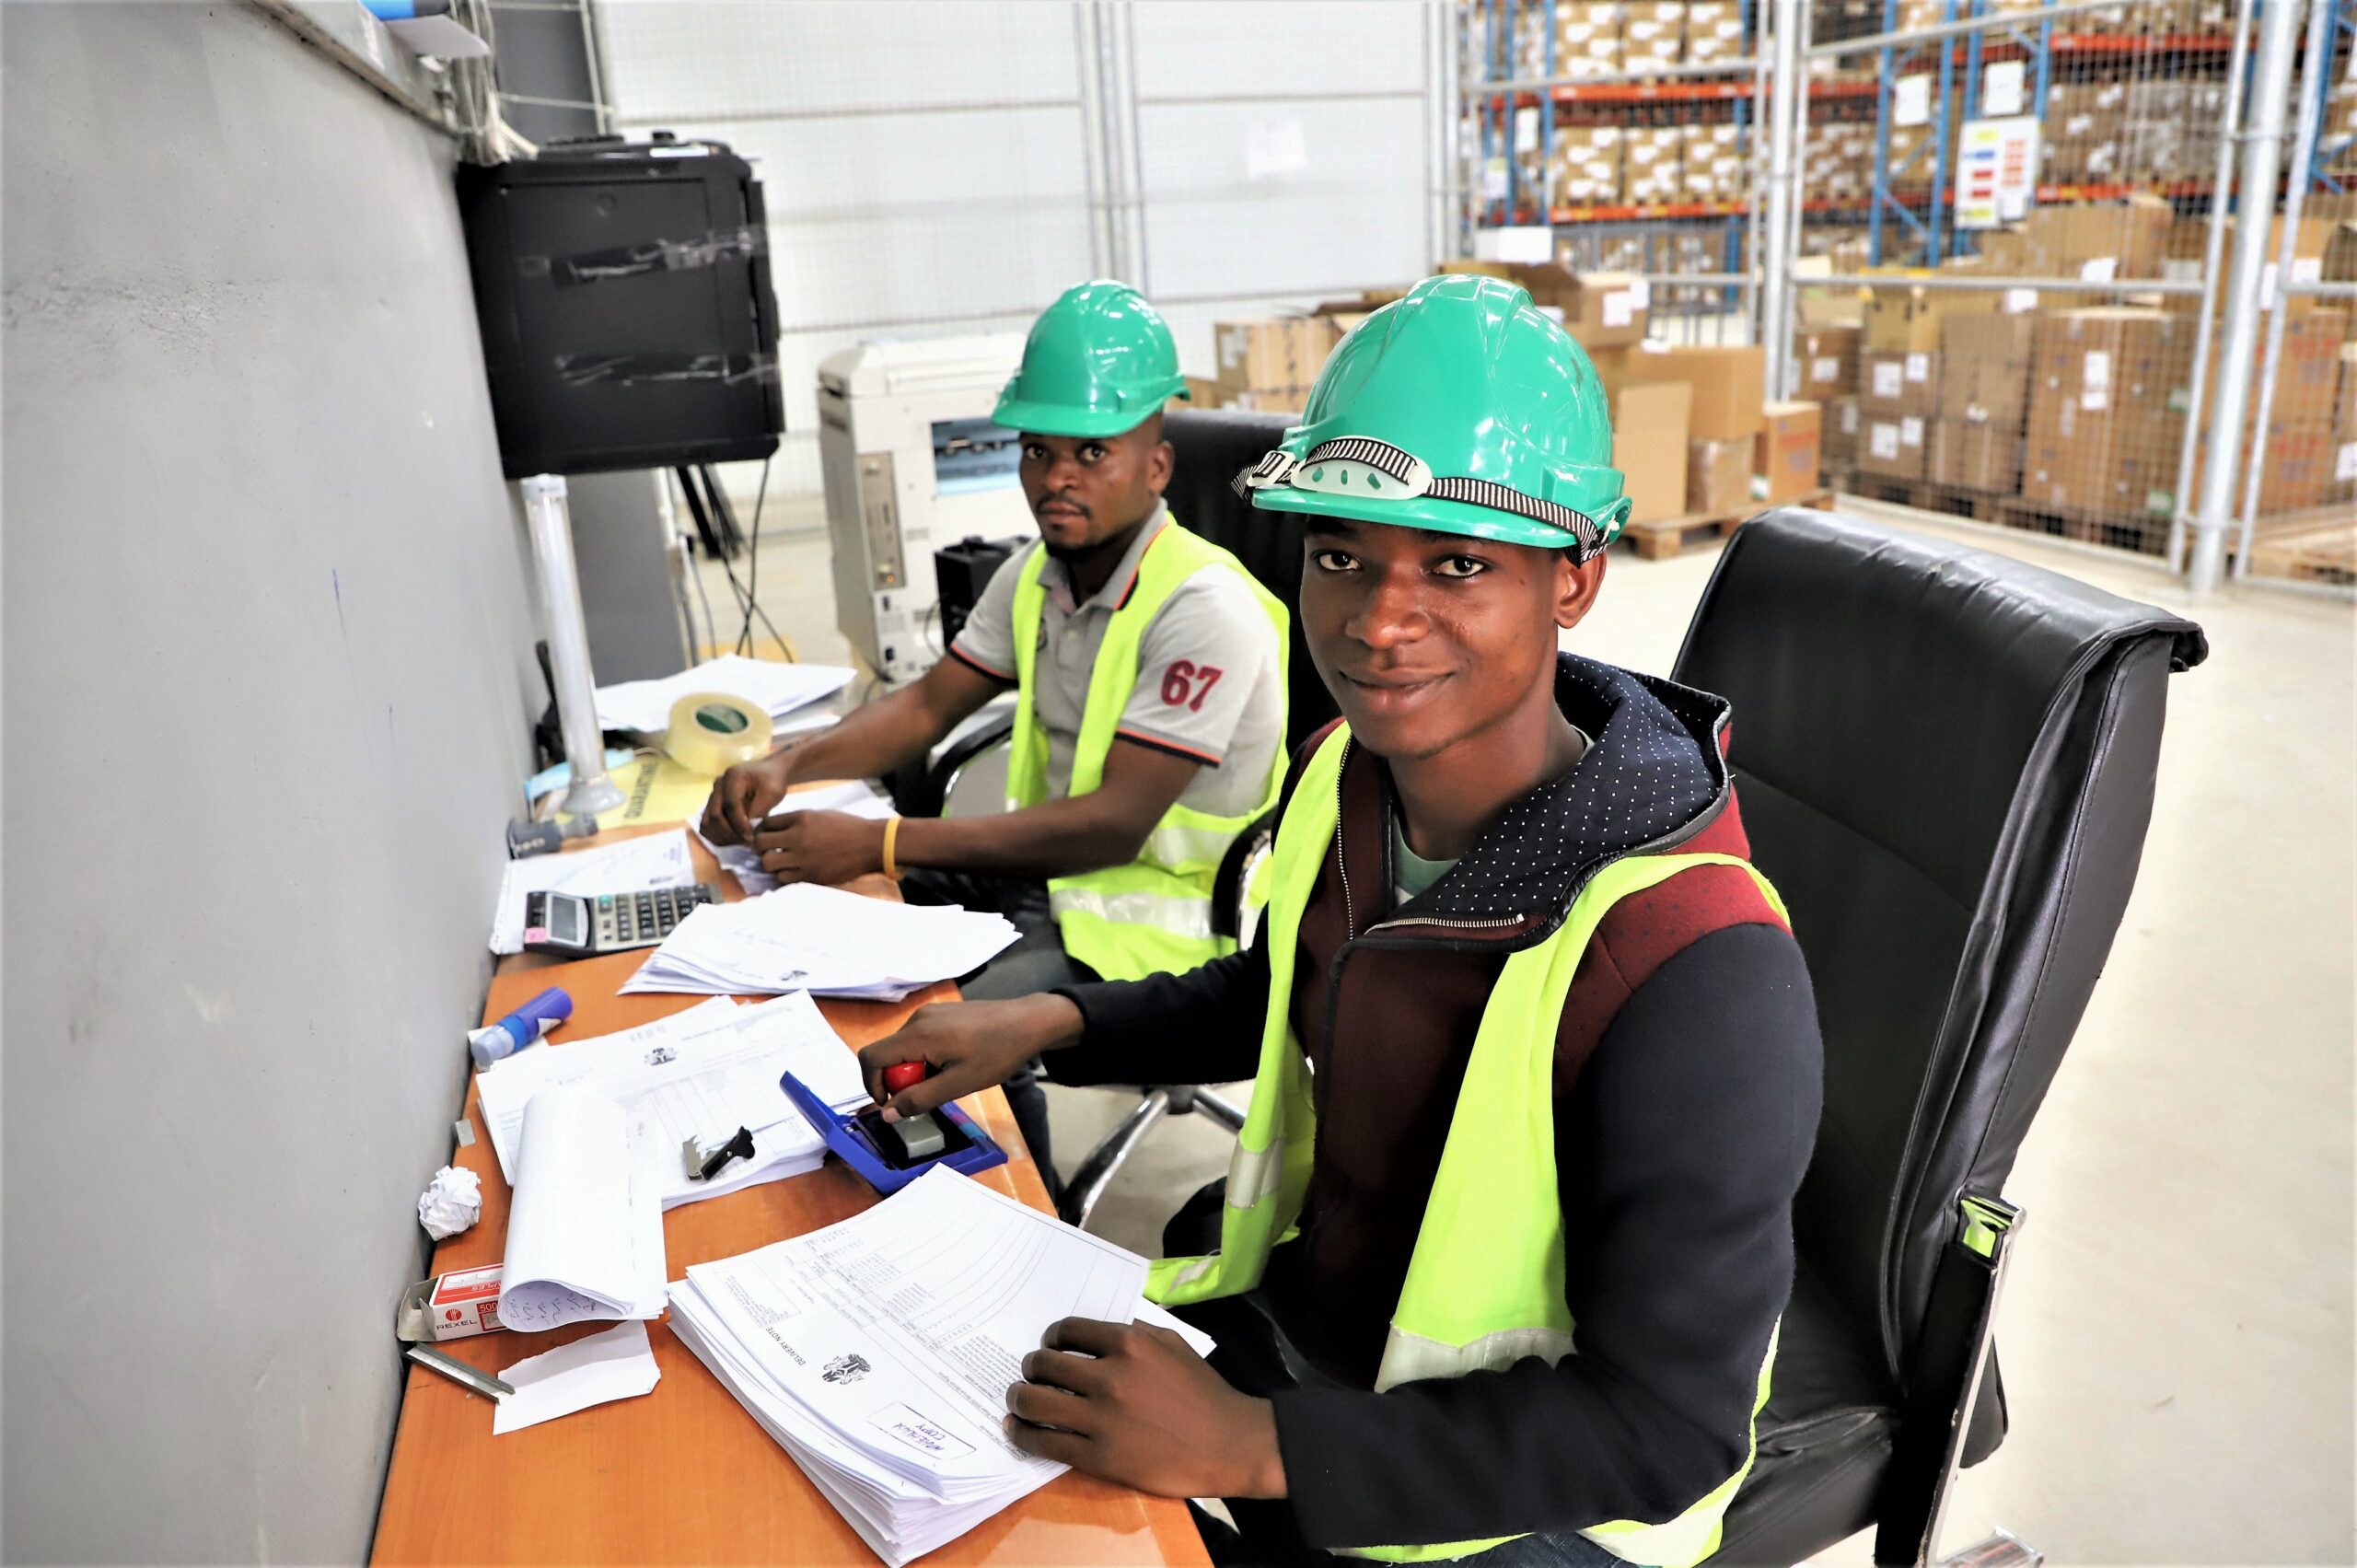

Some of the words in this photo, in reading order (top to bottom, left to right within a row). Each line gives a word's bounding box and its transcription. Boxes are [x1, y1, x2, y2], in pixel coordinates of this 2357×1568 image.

[1160, 659, 1223, 712] 67
[435, 1319, 478, 1330] REXEL
[766, 1326, 782, 1342] NOTE
[779, 1342, 806, 1365] DELIVERY
